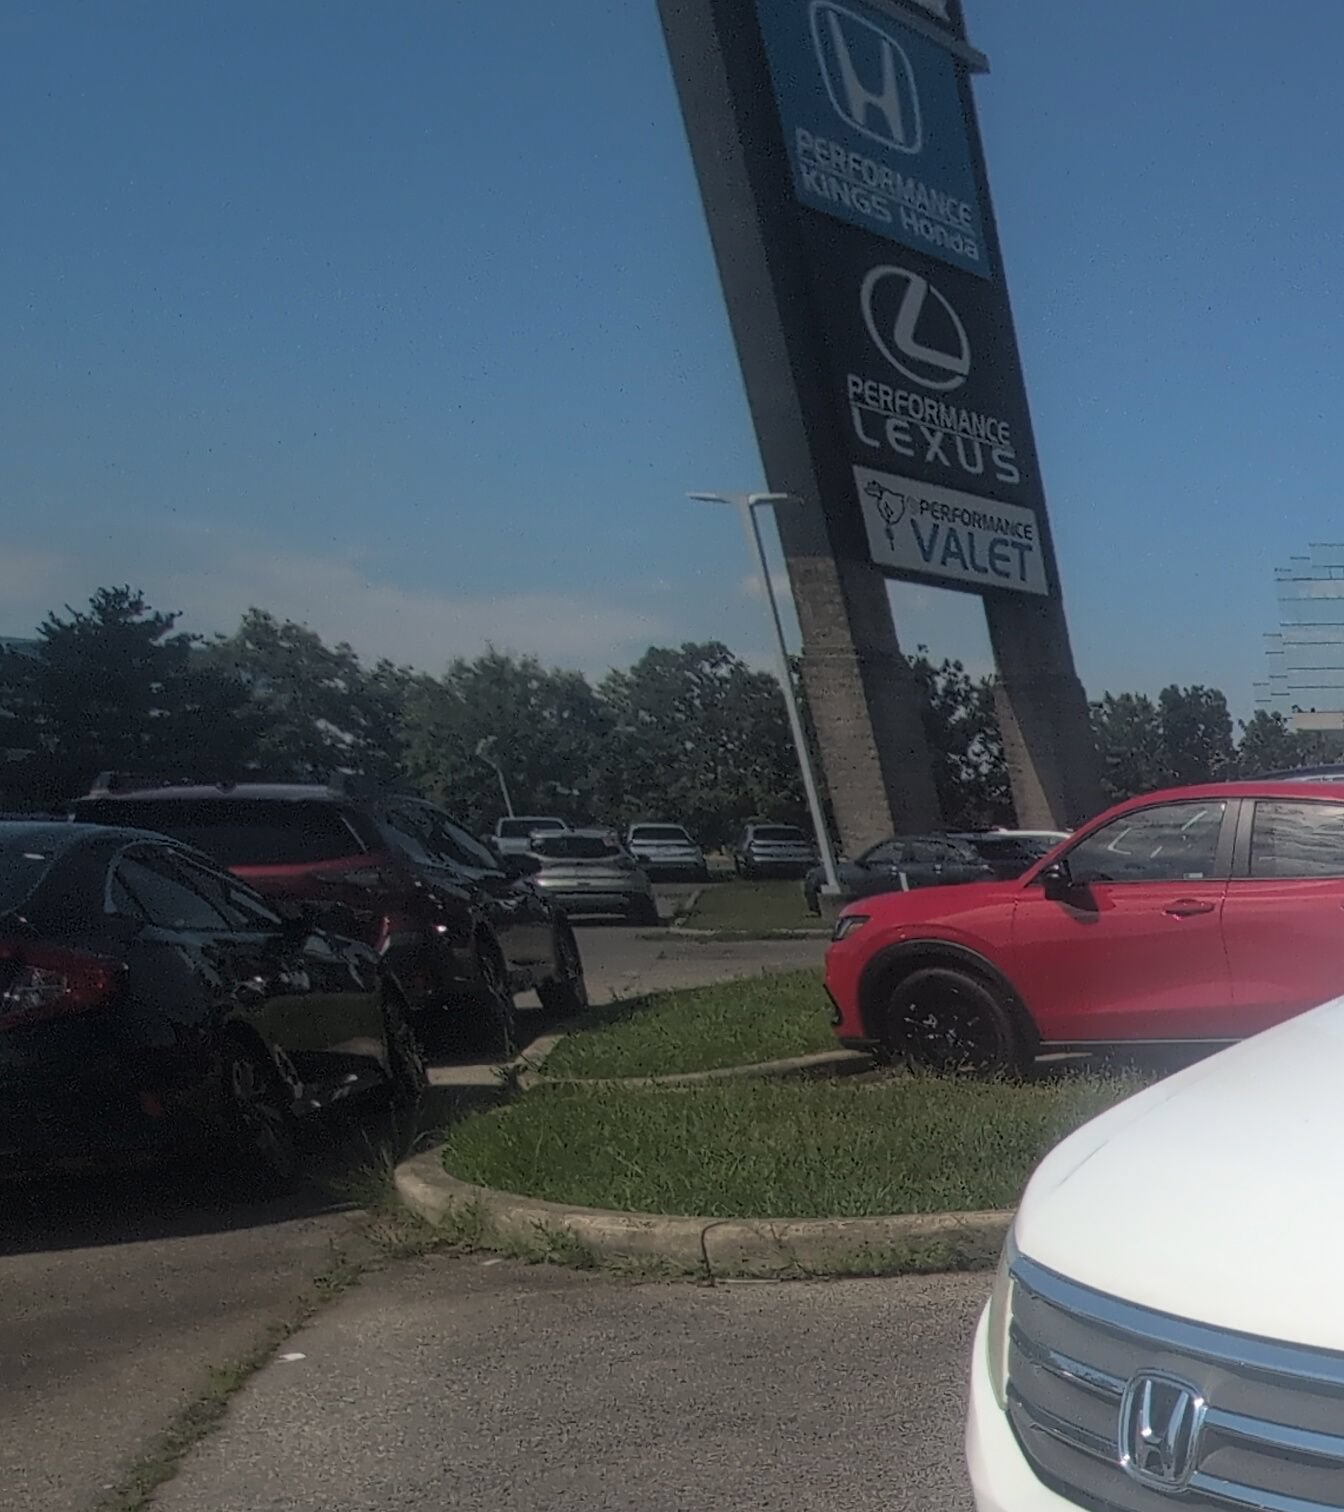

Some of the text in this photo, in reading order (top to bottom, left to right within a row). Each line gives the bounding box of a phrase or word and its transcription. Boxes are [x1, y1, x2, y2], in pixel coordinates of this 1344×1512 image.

[795, 127, 972, 225] PERFORMANCE
[801, 164, 979, 261] KINGS Honda
[848, 374, 1010, 445] PERFORMANCE
[852, 407, 1020, 484] LEXUS
[911, 518, 1033, 582] VALET
[920, 499, 1033, 540] PERFORMANCE
